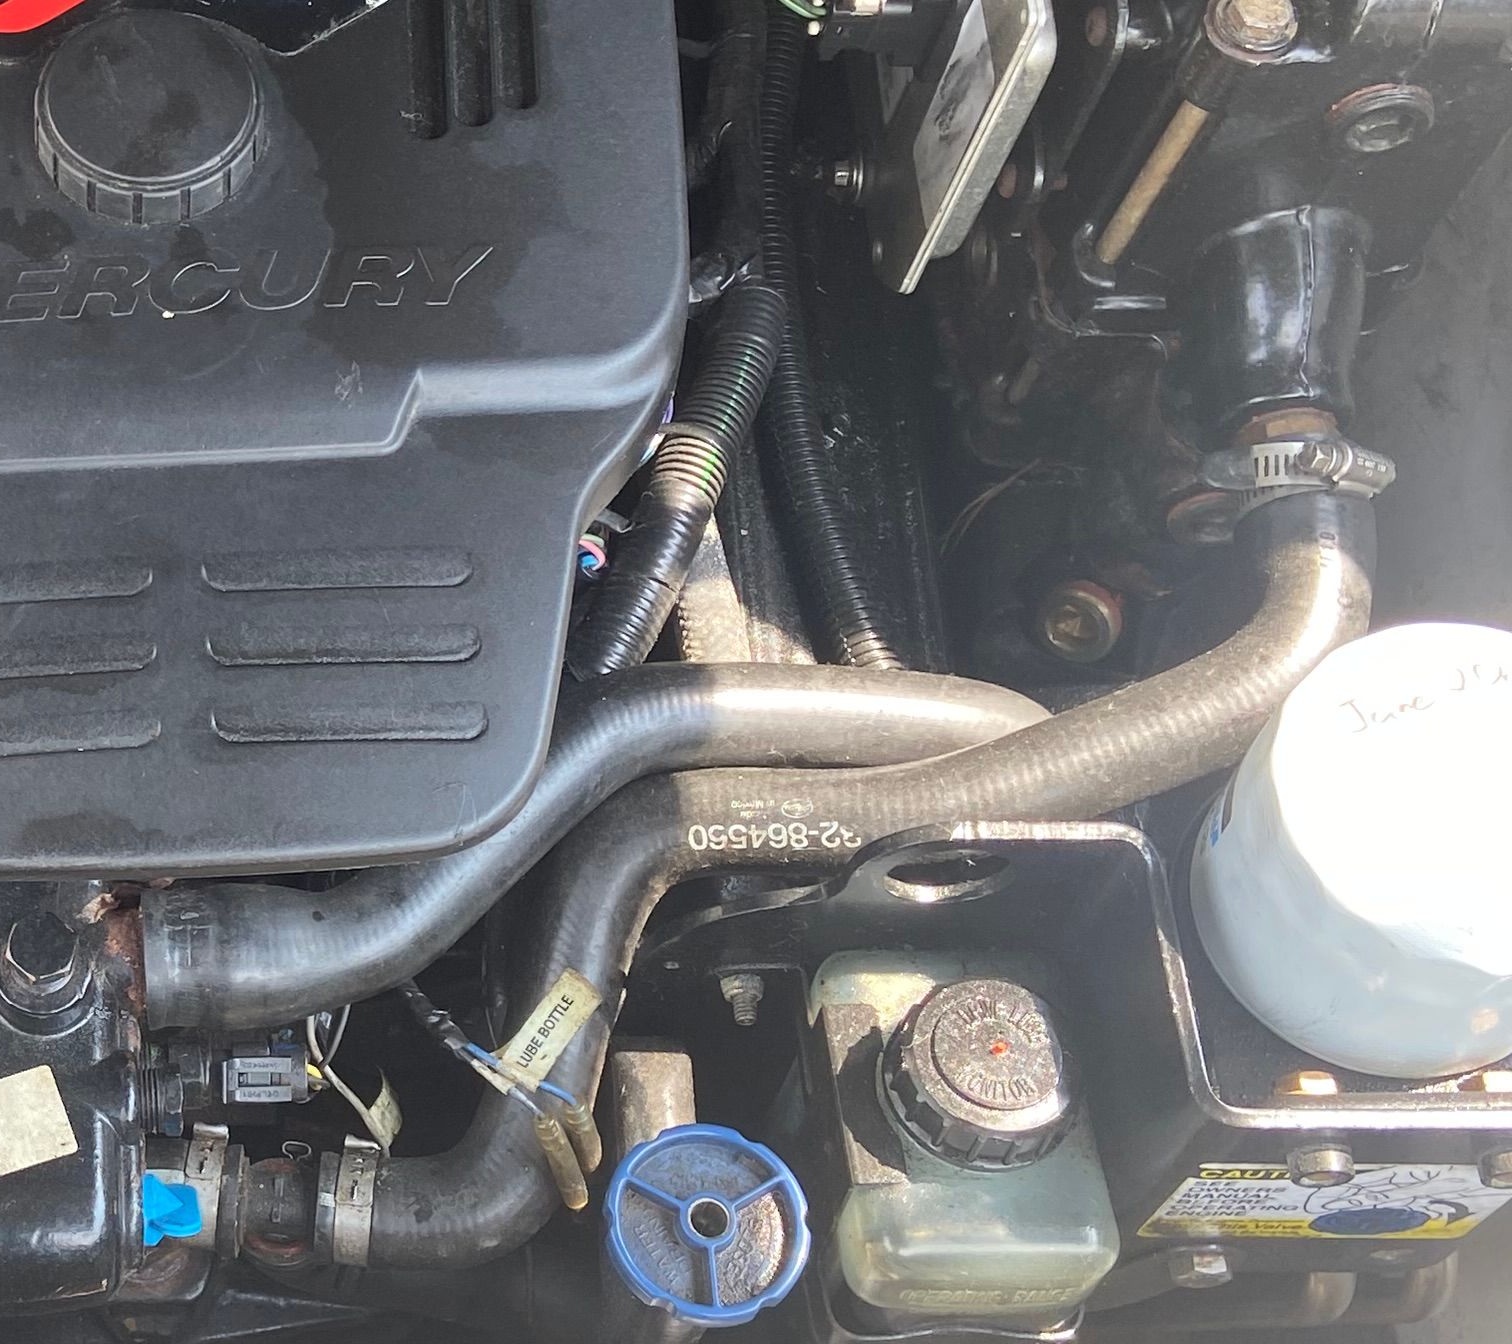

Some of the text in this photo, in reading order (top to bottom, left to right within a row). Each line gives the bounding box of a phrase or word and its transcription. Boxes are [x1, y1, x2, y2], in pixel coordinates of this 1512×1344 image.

[688, 820, 862, 852] 32-864550
[516, 993, 575, 1069] LUBE BOTTLE
[1200, 1169, 1290, 1178] CAUTI
[633, 1223, 680, 1286] WATER
